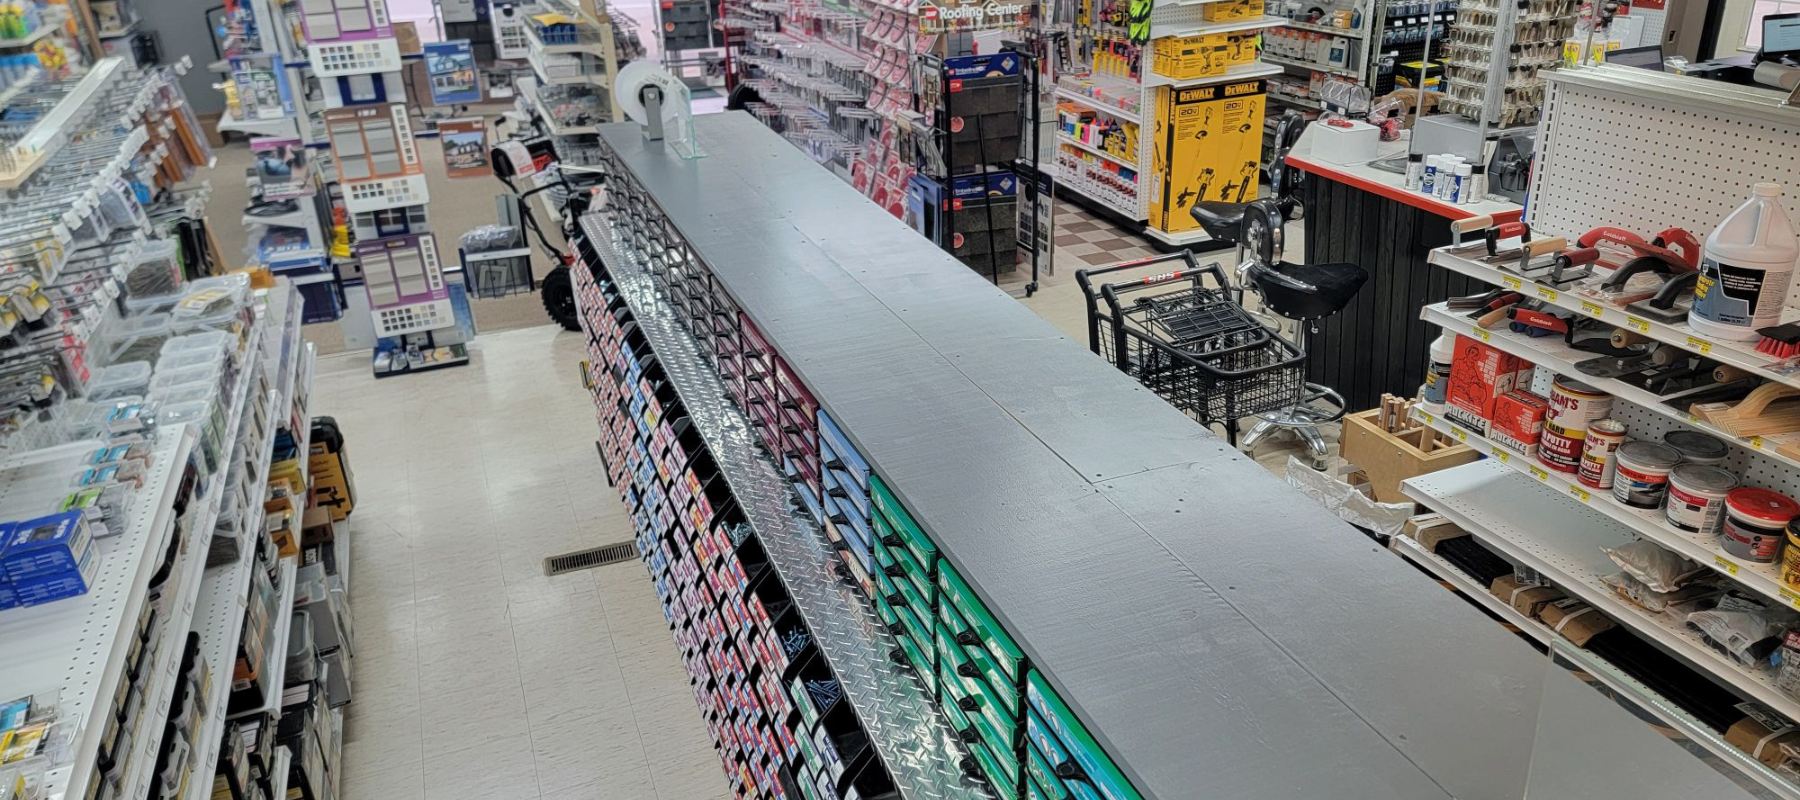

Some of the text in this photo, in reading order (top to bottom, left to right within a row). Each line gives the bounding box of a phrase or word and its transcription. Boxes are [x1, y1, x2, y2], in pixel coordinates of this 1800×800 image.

[939, 3, 1023, 20] Roofing Center
[1179, 88, 1214, 102] DEWALT
[1225, 82, 1259, 96] DEWALT
[1603, 230, 1626, 241] Goldblatt
[1446, 403, 1486, 428] ROCKITE
[1548, 423, 1565, 435] HARD
[1491, 430, 1527, 451] ROCKITE
[1548, 432, 1572, 449] PUTTY
